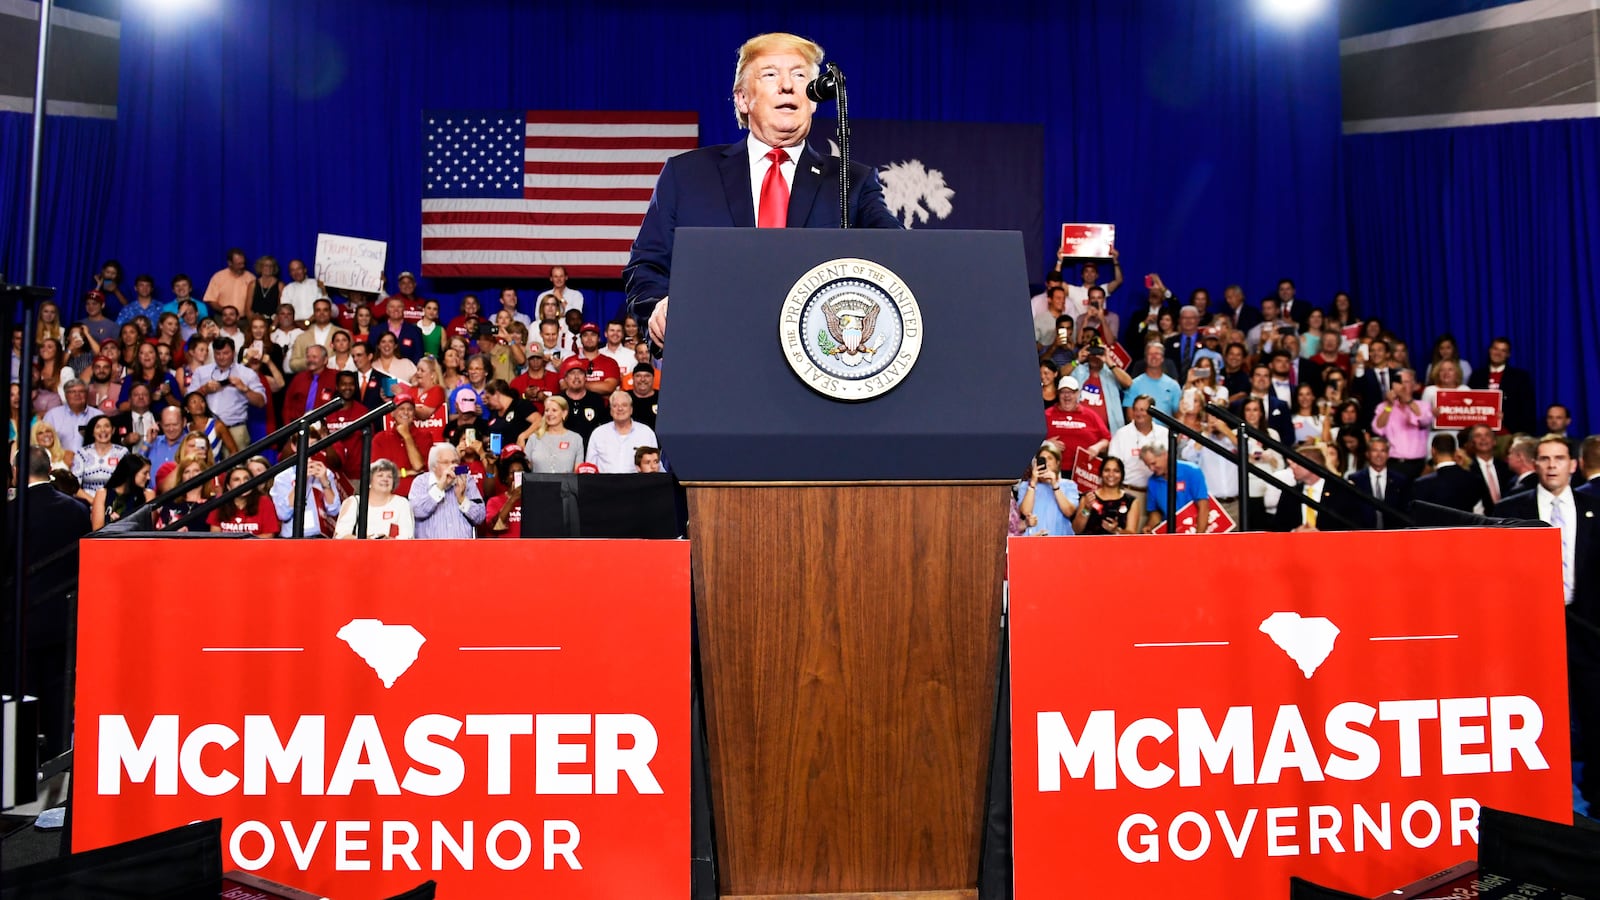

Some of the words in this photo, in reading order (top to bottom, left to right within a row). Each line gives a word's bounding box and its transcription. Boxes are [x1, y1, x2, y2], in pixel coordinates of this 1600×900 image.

[852, 265, 866, 274] OF
[868, 269, 886, 283] THE
[785, 263, 848, 324] PRESIDENT
[888, 282, 918, 339] UNITED
[788, 328, 798, 348] THE
[792, 350, 803, 363] OF
[804, 364, 840, 392] SEAL
[864, 350, 912, 393] STATES
[1439, 405, 1495, 415] McMASTER
[97, 713, 664, 797] McMASTER
[1036, 694, 1550, 792] McMASTER
[187, 819, 583, 872] OVERNOR
[1117, 799, 1480, 864] GOVERNOR
